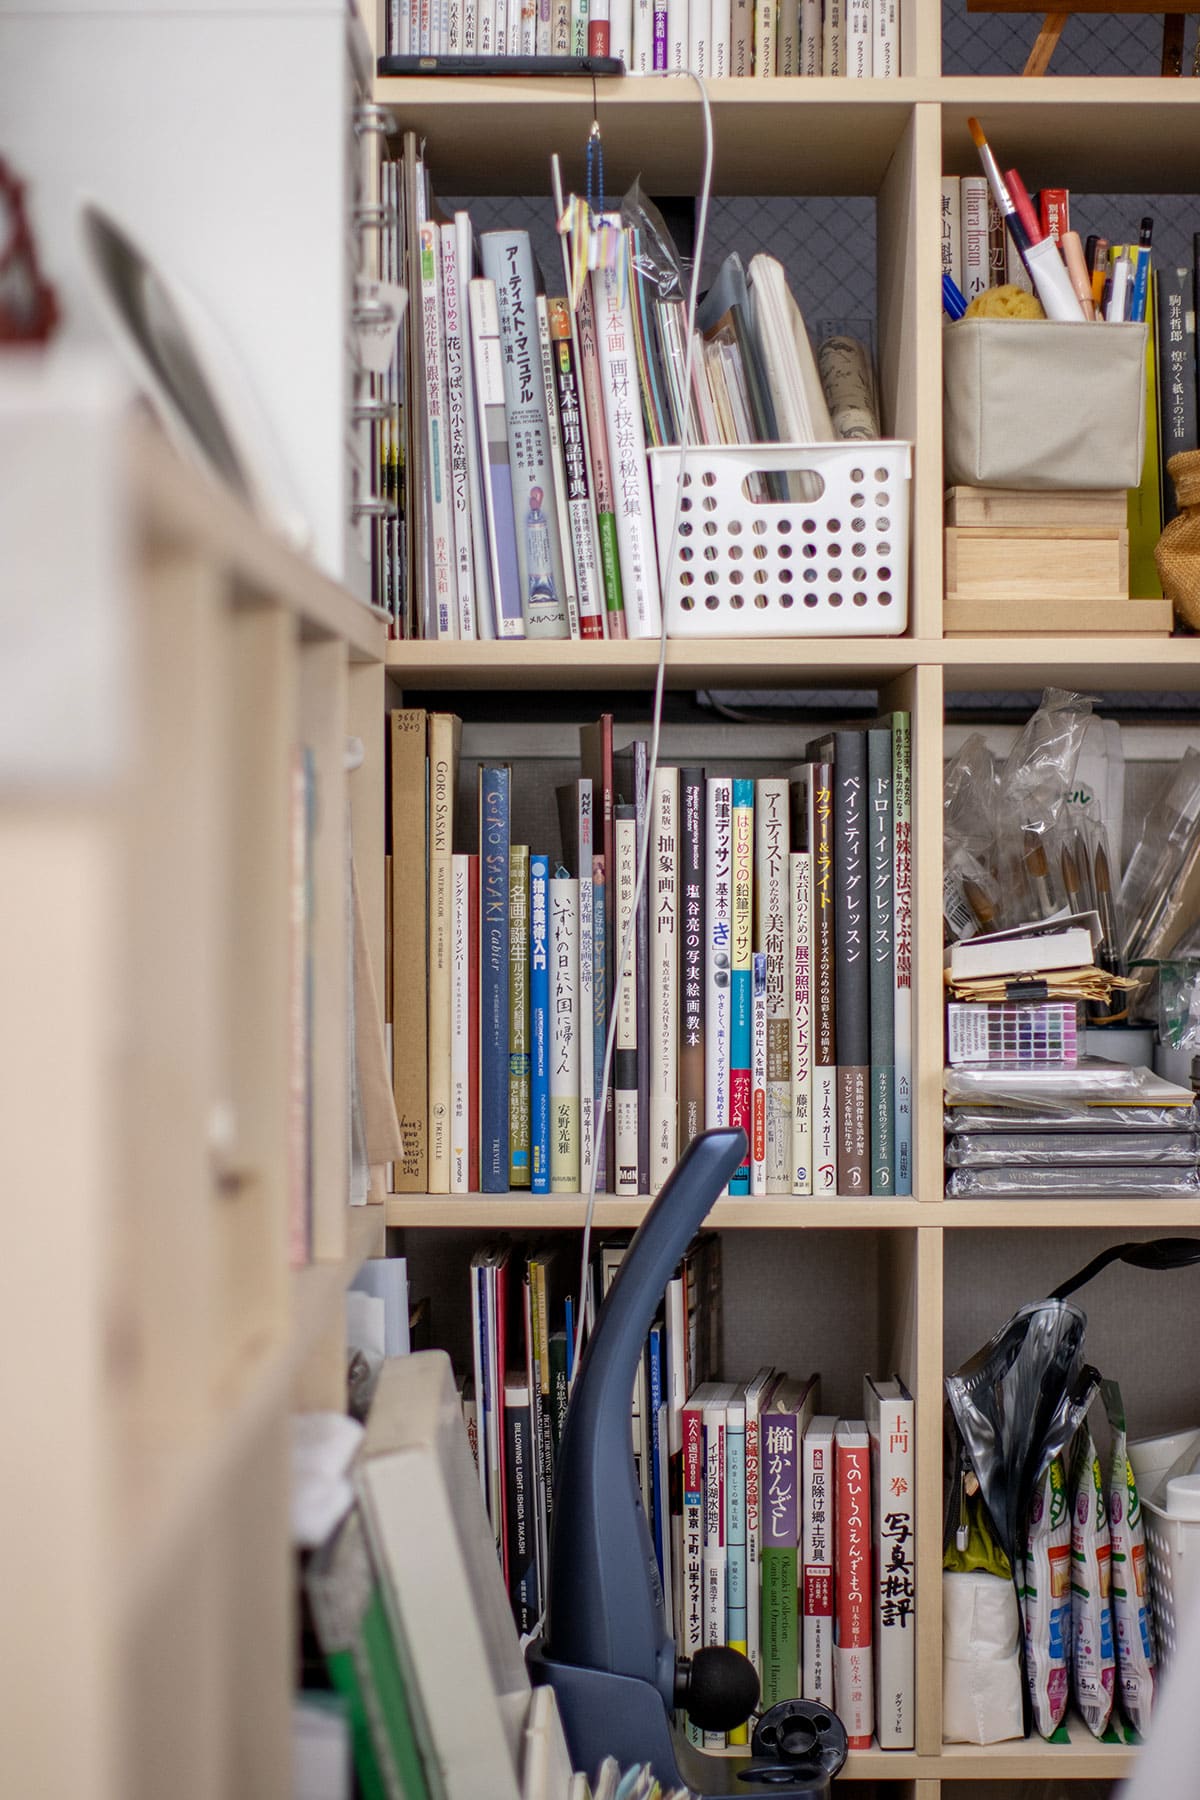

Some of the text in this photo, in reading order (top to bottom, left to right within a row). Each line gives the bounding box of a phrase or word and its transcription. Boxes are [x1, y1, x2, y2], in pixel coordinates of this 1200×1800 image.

[697, 40, 705, 78] グラフィック
[762, 36, 770, 78] グラフィック
[505, 246, 534, 404] アーティスト・マニュアル
[606, 297, 625, 352] 日本画
[1169, 295, 1185, 438] 駒井哲郎 煌めく紙上の宇宙
[447, 336, 468, 513] 花いっぱいの小さな庭づくり
[560, 374, 588, 498] 日本画用語事典
[608, 359, 642, 517] 画材と技法の秘伝集
[503, 619, 516, 628] 24
[528, 613, 566, 625] メルヘン社
[435, 804, 448, 851] SASAKI
[582, 793, 591, 815] NHK
[714, 787, 730, 878] 鉛筆デッサン
[657, 835, 675, 934] 抽象画入門
[765, 792, 784, 1014] アーティストのための美術解剖学
[843, 775, 861, 963] ペインティングレッスン
[873, 777, 890, 963] ドローイングレッスン
[895, 821, 912, 989] 特殊技法で学ぶ水墨画
[509, 886, 528, 961] 名画の誕生
[581, 881, 592, 992] 安野光雅 風景画を描く
[686, 884, 700, 1046] 塩谷亮の写実絵画教本
[795, 860, 809, 1082] 学芸員のための展示照明ハンドブック
[755, 1001, 765, 1086] 風景の中に人を描く
[493, 1138, 501, 1175] TREVILLE
[558, 1103, 571, 1154] 安野光雅
[822, 1079, 831, 1157] ジェームス・ガーニー
[514, 1422, 523, 1465] BILLOWING
[686, 1417, 699, 1488] 大人の遠足BOOK
[708, 1442, 719, 1534] イギリス湖水地方
[765, 1425, 794, 1538] 櫛かんざし
[814, 1451, 823, 1469] 全国
[889, 1414, 908, 1497] 土門 拳
[517, 1494, 525, 1520] ISHIDA
[518, 1521, 526, 1555] TAKASHI
[811, 1472, 826, 1562] 厄除け郷土玩具
[847, 1454, 863, 1603] てのひらのえんぎもの
[687, 1507, 700, 1643] 東京 下町・山手ウォーキング
[880, 1513, 915, 1628] 写真批評
